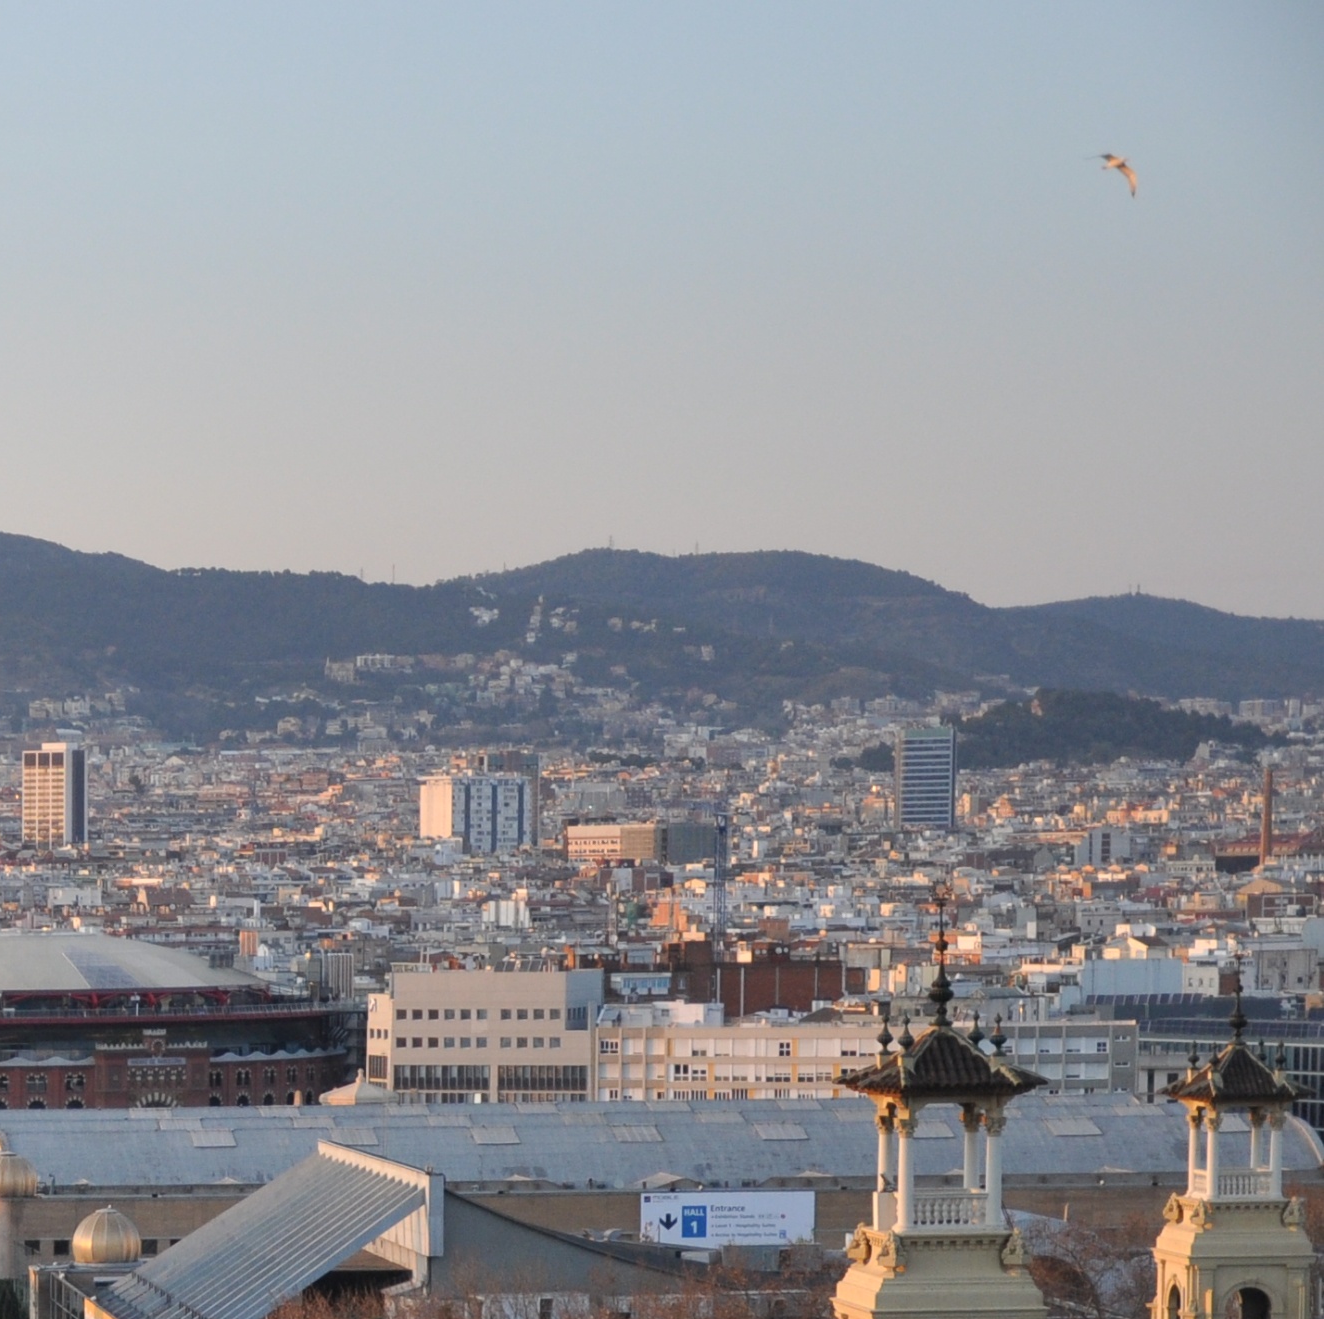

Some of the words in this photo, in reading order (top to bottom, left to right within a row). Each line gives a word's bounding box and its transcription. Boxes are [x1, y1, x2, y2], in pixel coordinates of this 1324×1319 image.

[683, 1208, 705, 1217] HALL
[710, 1204, 746, 1213] Entrance
[690, 1220, 699, 1235] 1
